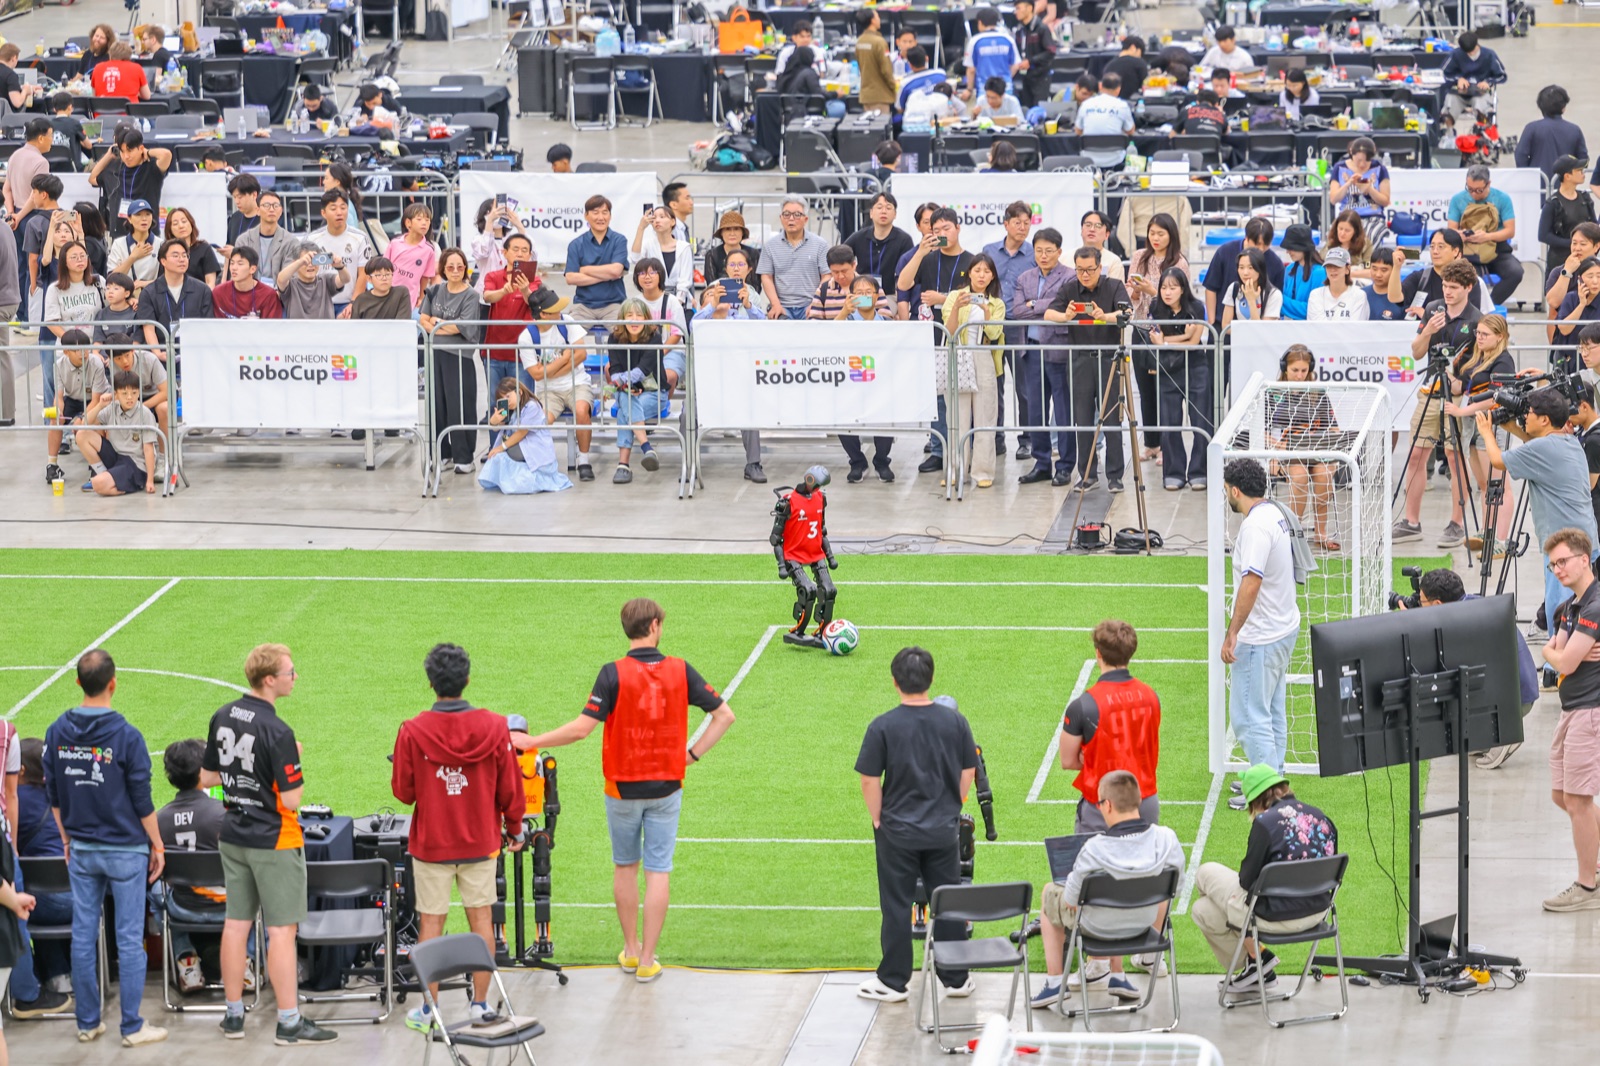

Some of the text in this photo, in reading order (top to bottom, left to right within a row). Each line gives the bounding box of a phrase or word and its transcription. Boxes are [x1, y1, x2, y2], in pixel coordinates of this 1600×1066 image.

[521, 215, 583, 232] oboCup
[957, 212, 1005, 225] oboCu
[284, 354, 328, 363] INCHEON
[801, 356, 846, 366] INCHEON
[1339, 356, 1384, 365] INCHEON
[239, 364, 328, 385] RoboCup
[755, 367, 846, 387] RoboCup
[1312, 366, 1384, 383] boCup
[807, 521, 818, 539] 3
[216, 726, 256, 773] 34
[174, 811, 194, 826] DEV
[175, 831, 197, 852] 7
